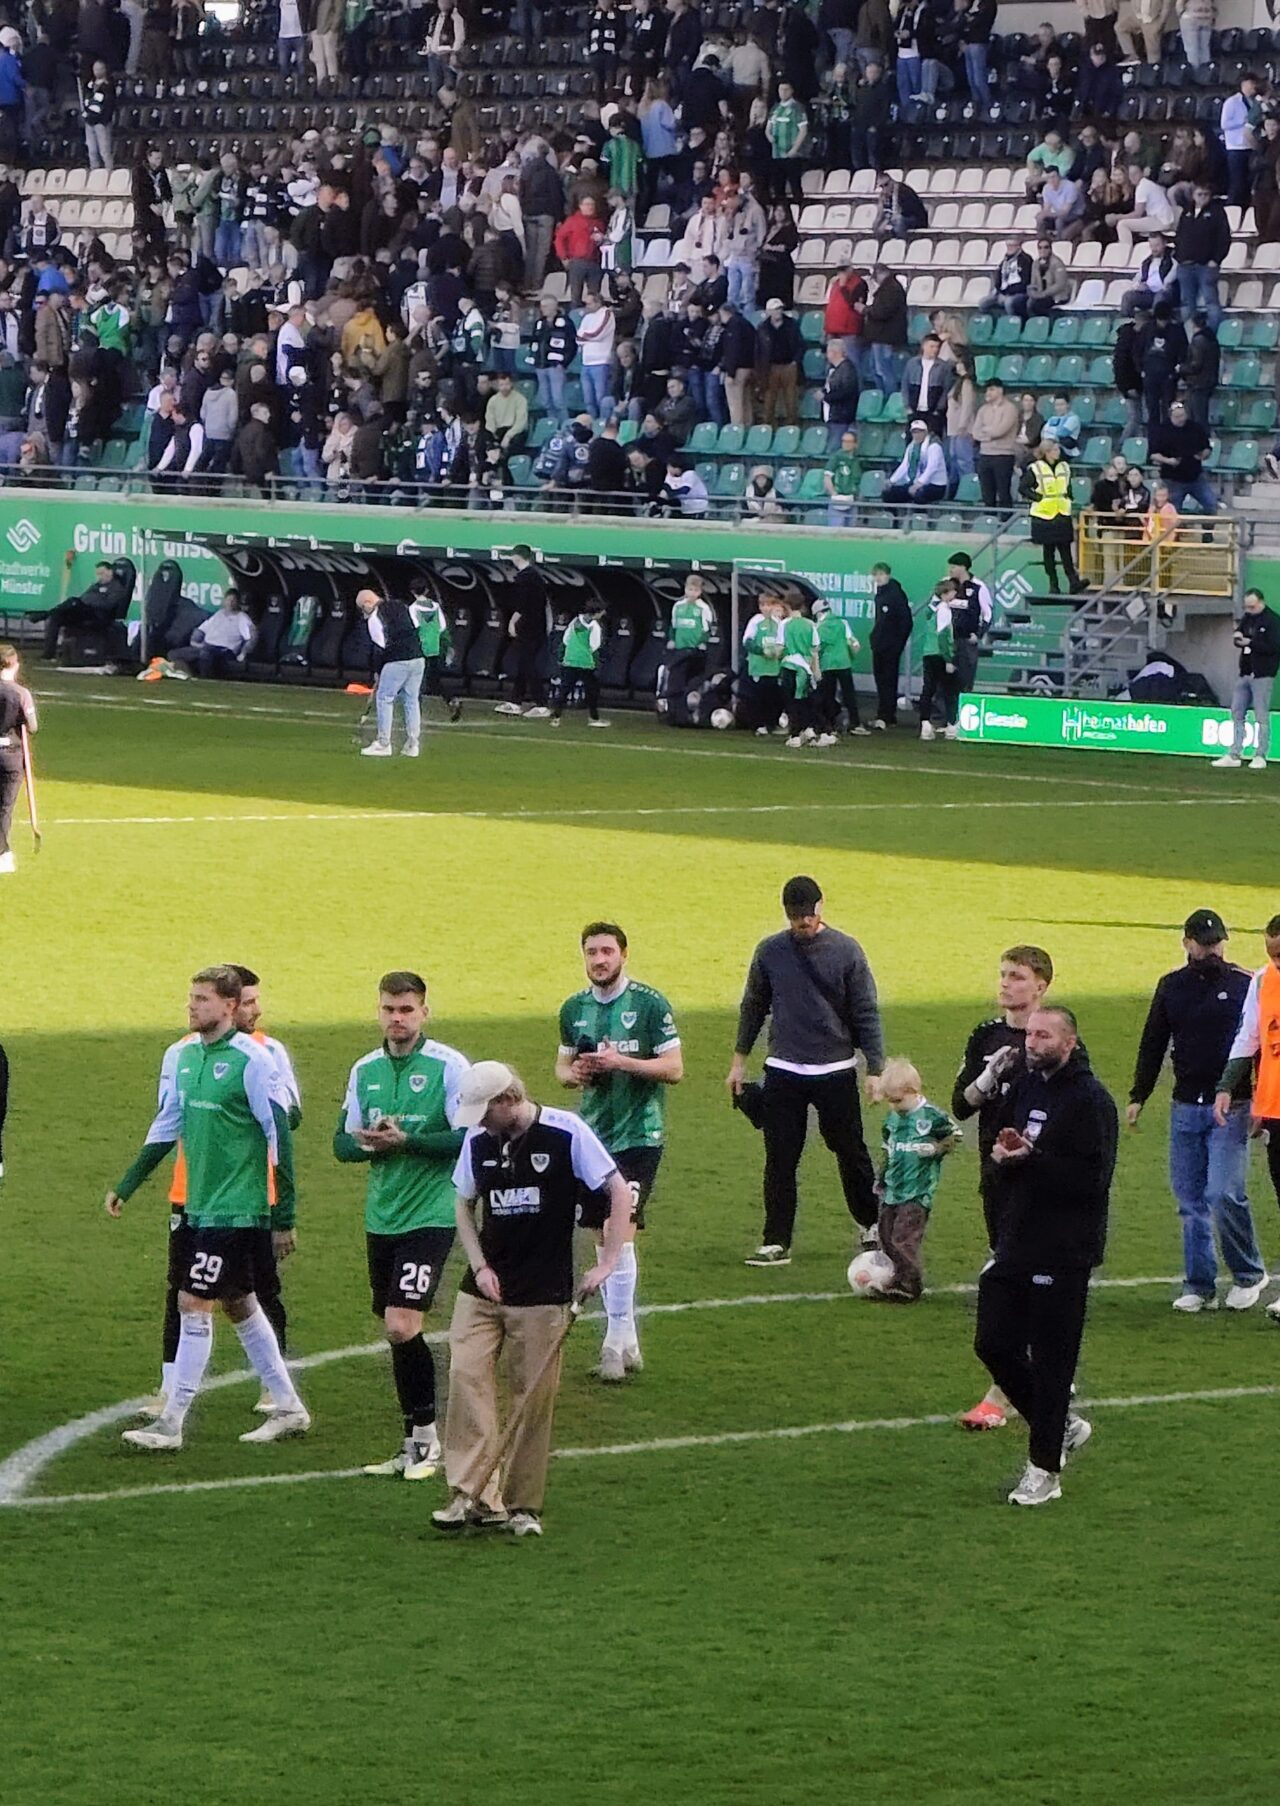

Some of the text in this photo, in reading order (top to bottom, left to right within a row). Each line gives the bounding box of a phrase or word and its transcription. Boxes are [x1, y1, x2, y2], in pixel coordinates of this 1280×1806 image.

[73, 523, 127, 555] Grün
[0, 578, 45, 595] Münster
[1083, 711, 1167, 733] heimathafen
[189, 1251, 223, 1284] 29
[399, 1262, 432, 1294] 26
